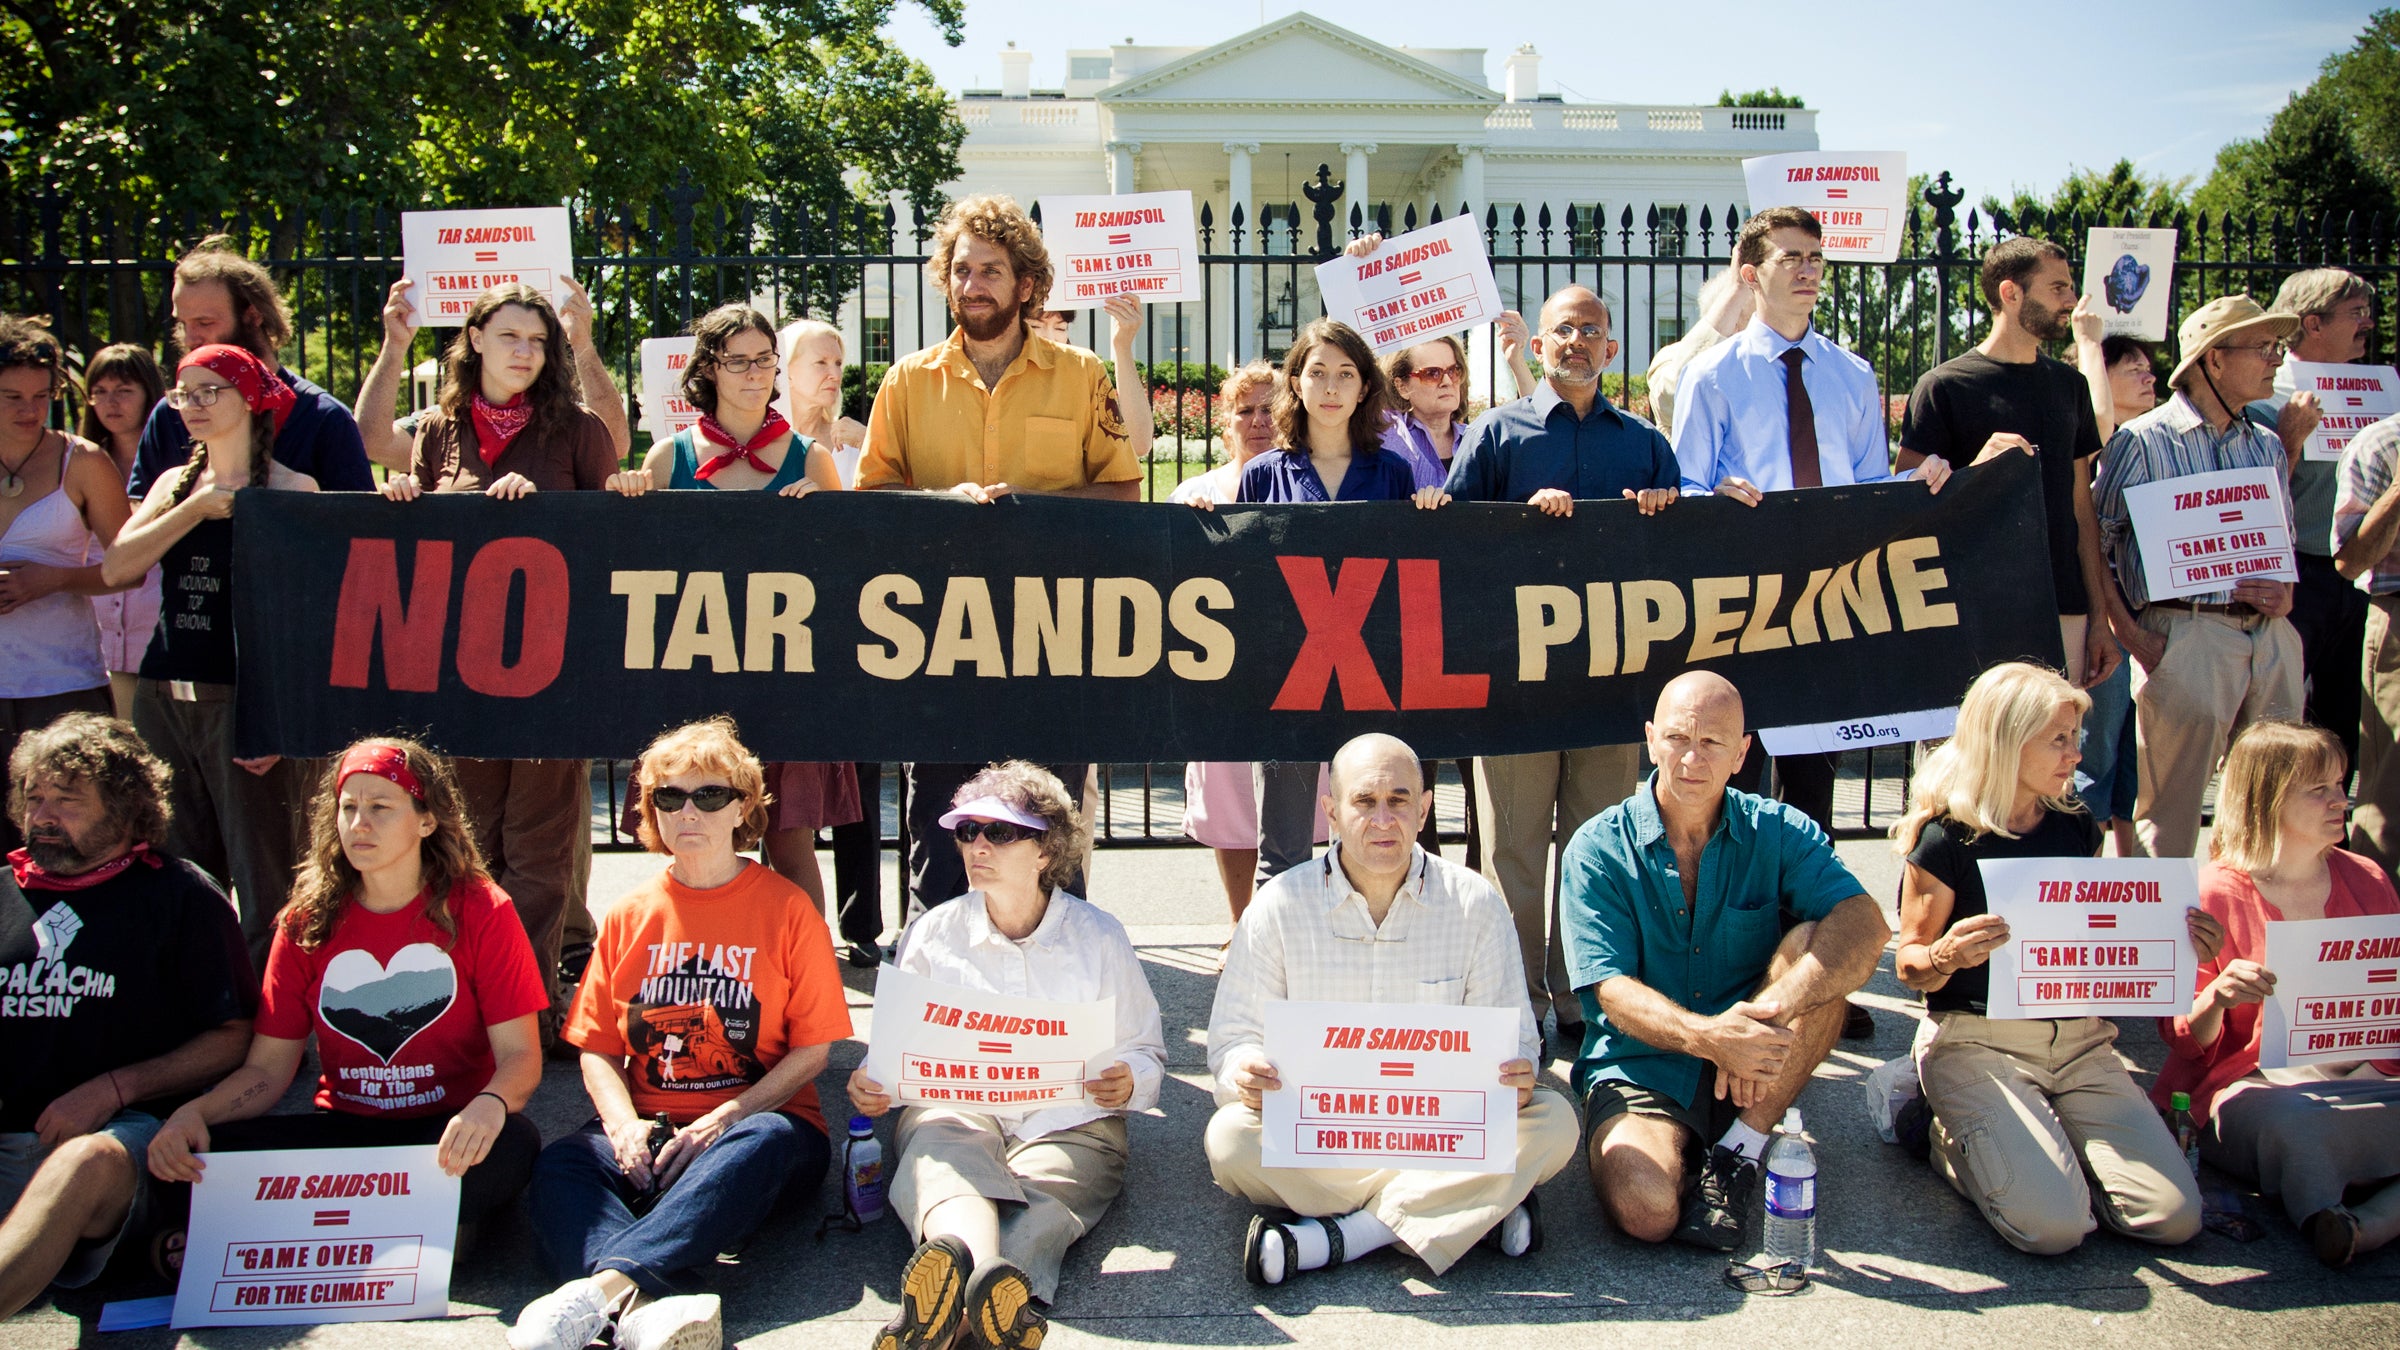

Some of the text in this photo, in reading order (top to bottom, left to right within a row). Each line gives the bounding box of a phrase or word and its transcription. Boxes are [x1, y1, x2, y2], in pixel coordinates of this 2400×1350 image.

[1787, 168, 1813, 182] TAR
[1075, 212, 1096, 227] TAR
[1833, 211, 1862, 225] OVER
[438, 229, 462, 244] TAR
[1117, 254, 1152, 269] OVER
[1357, 260, 1382, 281] TAR
[1077, 284, 1095, 296] FOR
[1097, 282, 1118, 295] THE
[1411, 287, 1447, 308] OVER
[440, 301, 460, 313] FOR
[1375, 328, 1396, 344] FOR
[1398, 322, 1418, 337] THE
[667, 354, 688, 369] TAR
[2316, 377, 2334, 390] TAR
[2327, 439, 2343, 449] FOR
[2174, 491, 2202, 511] TAR
[2231, 532, 2267, 550] OVER
[191, 556, 210, 572] STOP
[2186, 566, 2210, 582] FOR
[2211, 562, 2234, 577] THE
[178, 575, 220, 592] MOUNTAIN
[188, 595, 204, 610] TOP
[329, 536, 1959, 711] NO TAR SANDS XL PIPELINE
[2038, 881, 2072, 902] TAR
[2095, 947, 2138, 966] OVER
[2318, 940, 2354, 962] TAR
[648, 942, 757, 980] THE LAST
[640, 976, 753, 1010] MOUNTAIN
[2036, 982, 2062, 1000] FOR
[2066, 982, 2090, 998] THE
[923, 1002, 962, 1027] TAR
[1323, 1027, 1365, 1049] TAR
[2308, 1033, 2335, 1050] FOR
[2338, 1032, 2364, 1047] THE
[722, 1078, 748, 1086] FUTU
[987, 1066, 1040, 1080] OVER
[360, 1080, 415, 1096] For The
[920, 1088, 950, 1099] FOR
[957, 1089, 984, 1101] THE
[1387, 1095, 1440, 1116] OVER
[1317, 1130, 1347, 1149] FOR
[1352, 1131, 1381, 1149] THE
[255, 1176, 301, 1200] TAR
[317, 1244, 374, 1267] OVER
[235, 1287, 270, 1306] FOR
[275, 1285, 307, 1304] THE
